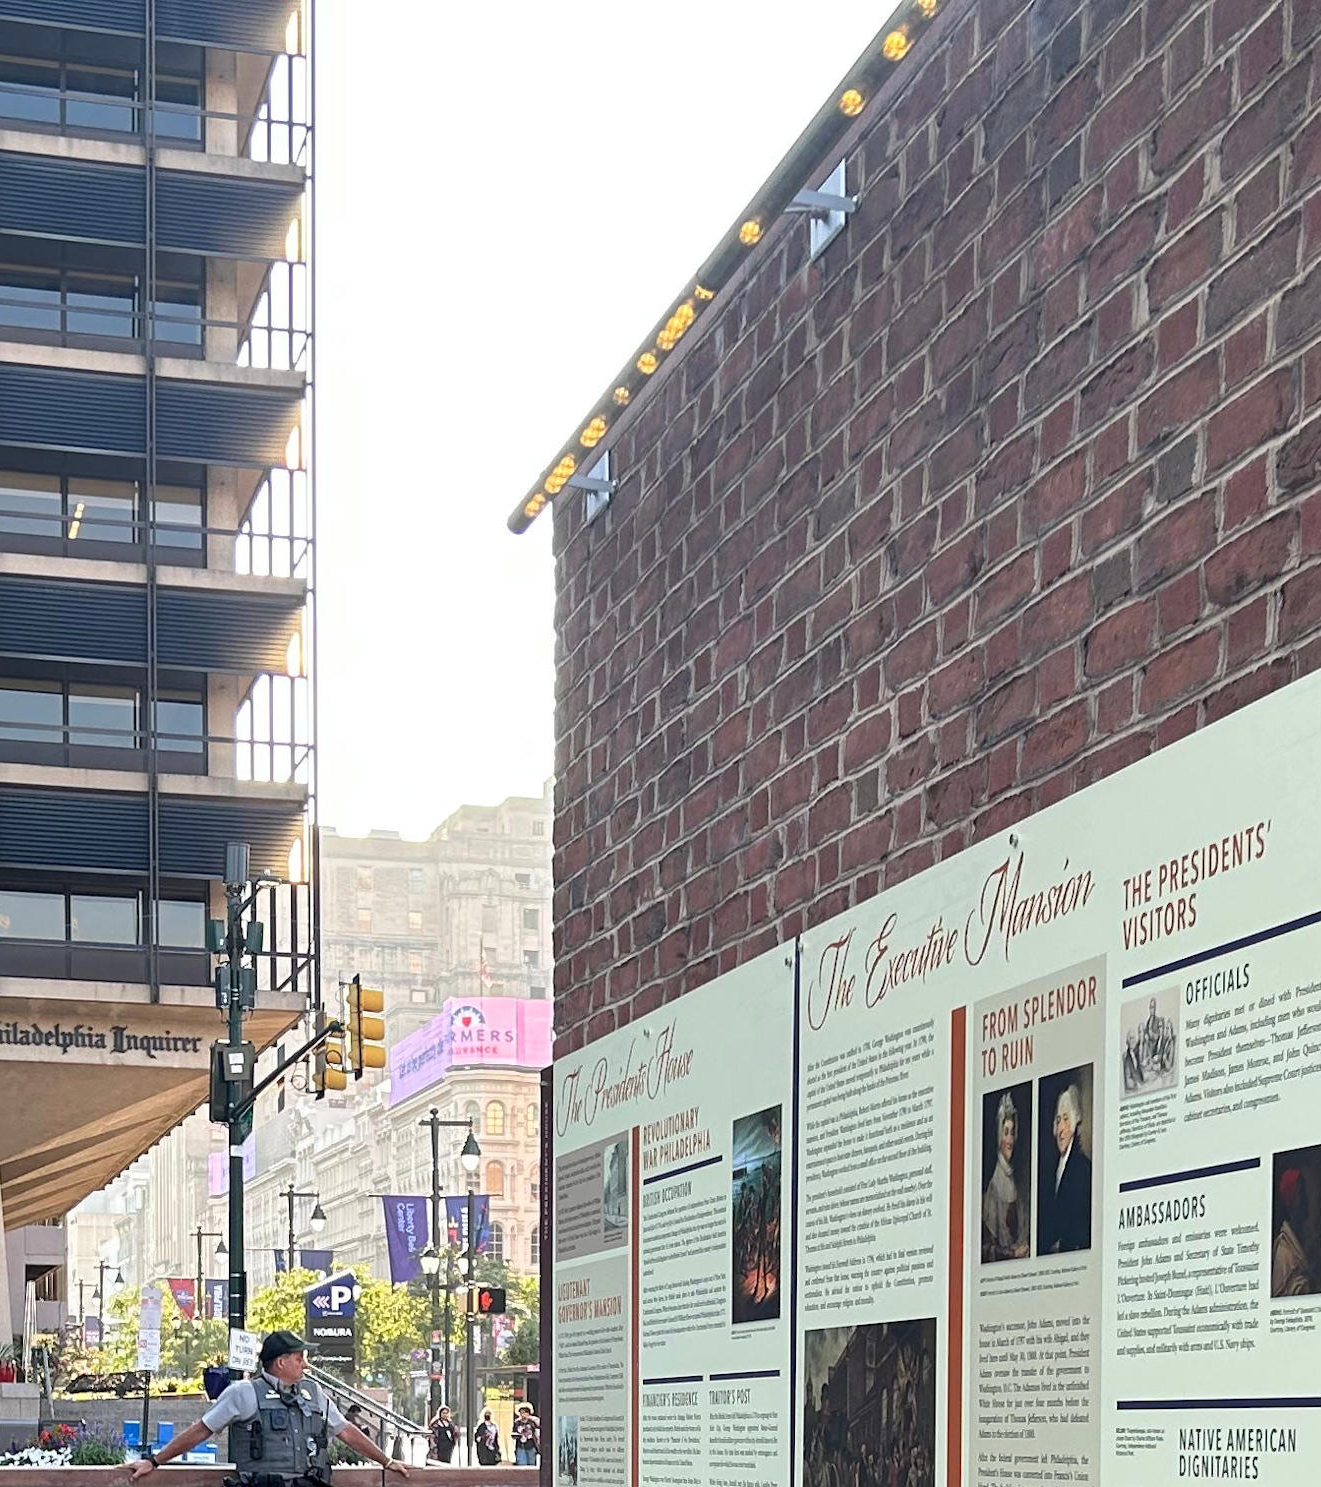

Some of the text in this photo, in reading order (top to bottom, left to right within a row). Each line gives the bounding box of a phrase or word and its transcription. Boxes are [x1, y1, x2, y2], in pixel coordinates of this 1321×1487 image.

[1123, 819, 1270, 910] THE PRESIDENTS'
[808, 851, 1096, 1030] The Executive Mansion
[1123, 892, 1196, 950] VISITORS
[1185, 963, 1249, 1005] OFFICIALS
[982, 975, 1096, 1042] FROM SPLENDOR
[110, 1025, 202, 1059] Inquirer
[446, 1029, 514, 1043] RMERS
[981, 1034, 1033, 1077] TO RUIN
[556, 1065, 583, 1137] The
[647, 1018, 693, 1100] House
[643, 1107, 699, 1147] REVOLUTIONARY
[643, 1129, 711, 1171] WAR PHILADELPHIA
[1118, 1194, 1205, 1229] AMBASSADORS
[331, 1285, 352, 1311] P
[235, 1345, 253, 1355] TURN
[240, 1335, 250, 1343] NO
[1179, 1428, 1221, 1450] NATIVE
[1226, 1428, 1295, 1451] AMERICAN
[1179, 1454, 1258, 1479] DIGNITARIES
